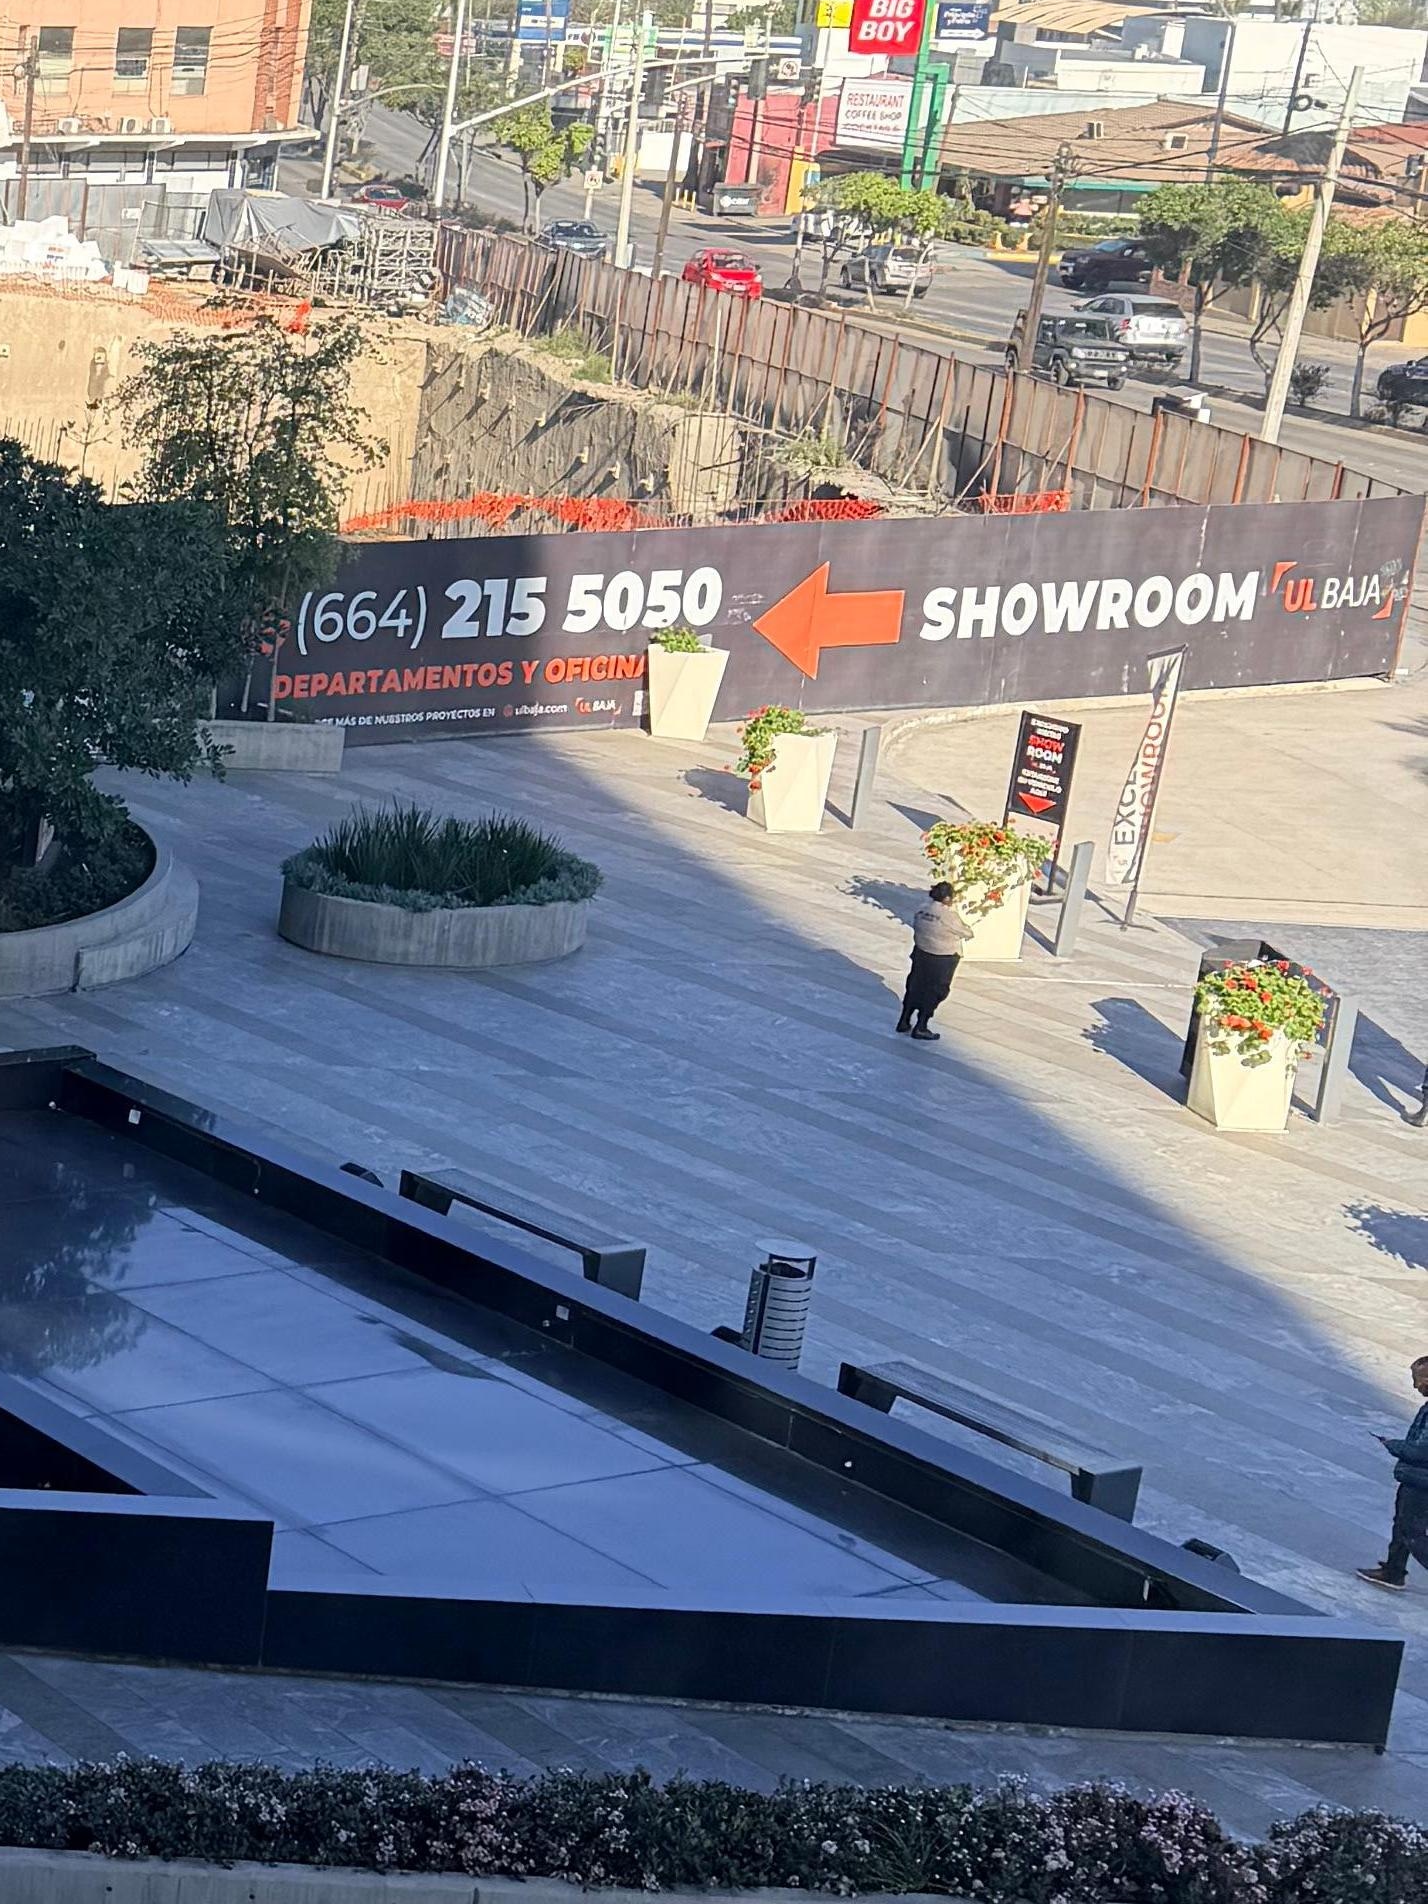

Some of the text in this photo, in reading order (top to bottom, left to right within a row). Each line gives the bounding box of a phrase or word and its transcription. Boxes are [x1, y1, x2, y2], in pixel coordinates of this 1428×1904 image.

[857, 20, 916, 42] BOY
[846, 92, 905, 108] RESTAURANT
[845, 109, 877, 121] COFFEE
[297, 585, 427, 656] (664)
[441, 577, 547, 639] 215
[562, 566, 724, 634] 5050
[919, 570, 1382, 642] SHOWROOM UL BAJA
[274, 660, 514, 700] DEPARTAMENTOS
[522, 659, 540, 685] Y
[515, 701, 568, 717] ulbaja.com
[593, 699, 616, 713] BAJA
[358, 715, 372, 726] DE
[374, 712, 424, 725] NUESTROS
[426, 707, 481, 721] PROYECTOS
[483, 707, 496, 718] EN
[1026, 745, 1063, 764] ROOM
